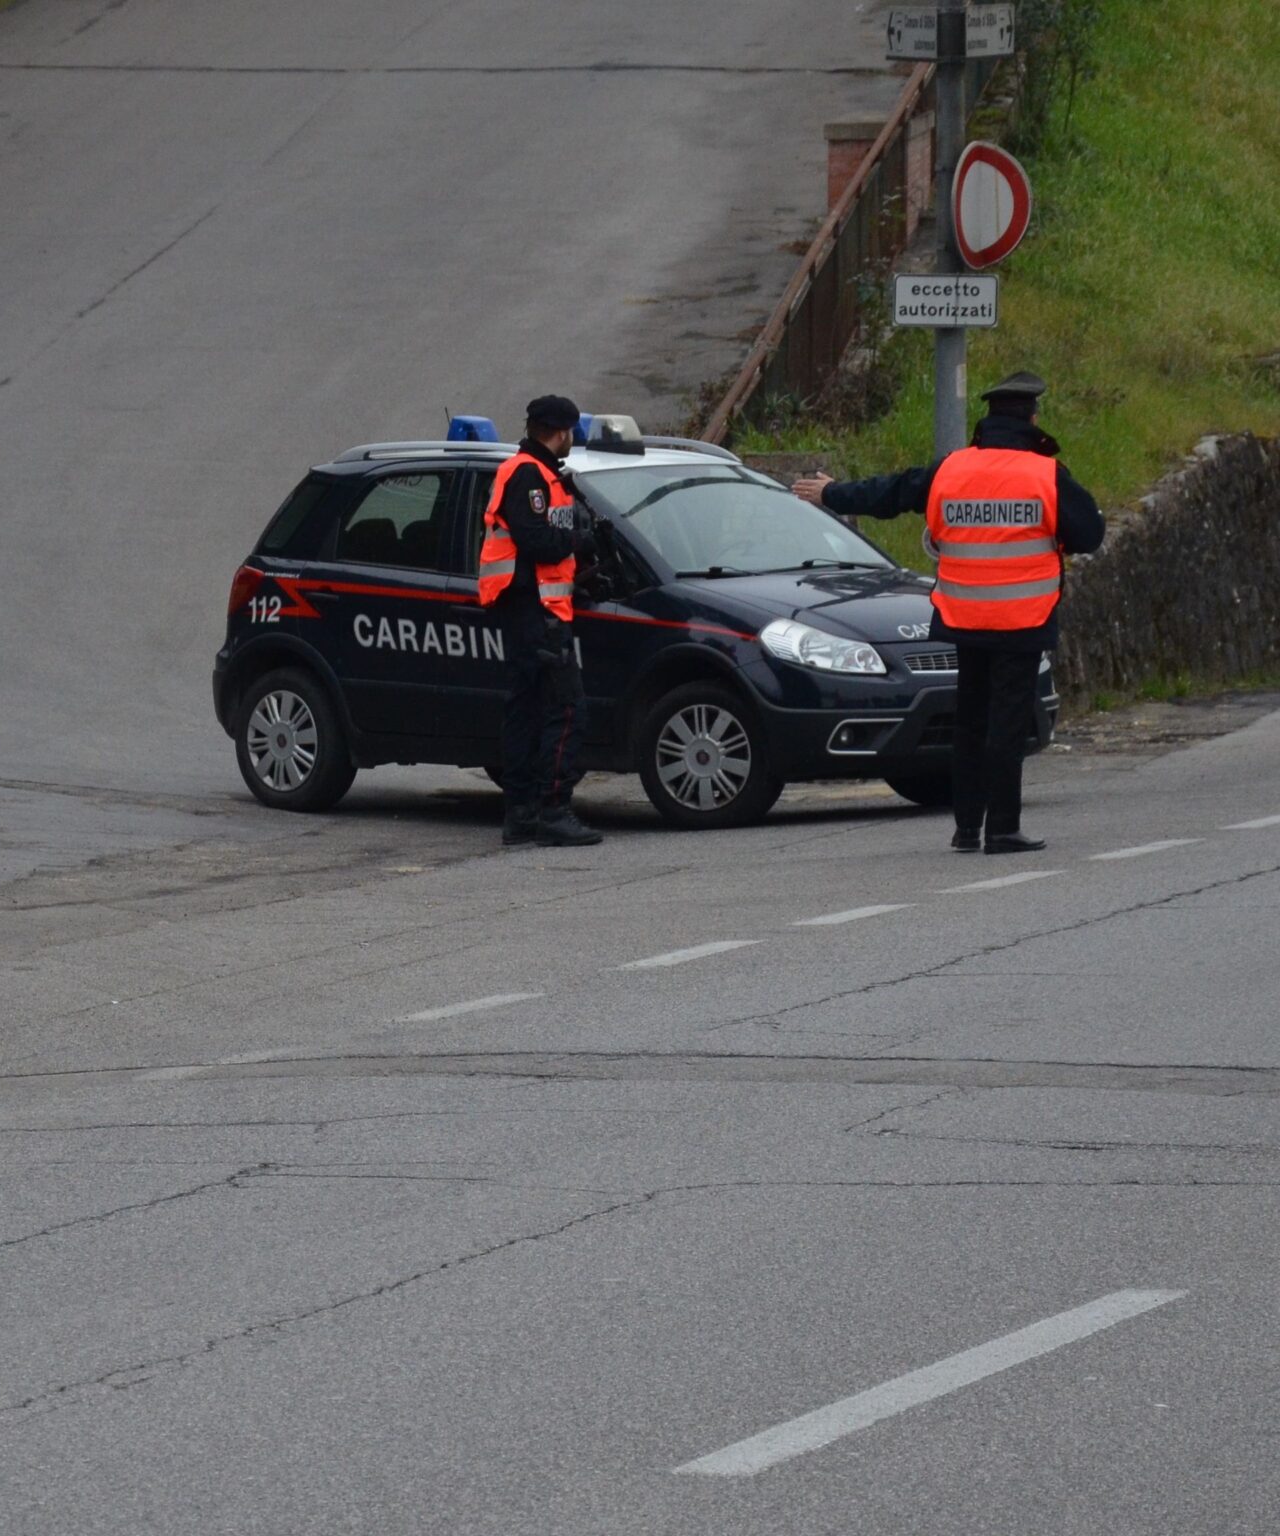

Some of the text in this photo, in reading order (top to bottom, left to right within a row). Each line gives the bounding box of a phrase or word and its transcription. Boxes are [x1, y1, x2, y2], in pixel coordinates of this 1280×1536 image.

[911, 282, 980, 296] eccetto
[899, 303, 992, 317] autorizzati
[946, 503, 1039, 523] CARABINIERI
[248, 595, 282, 624] 112
